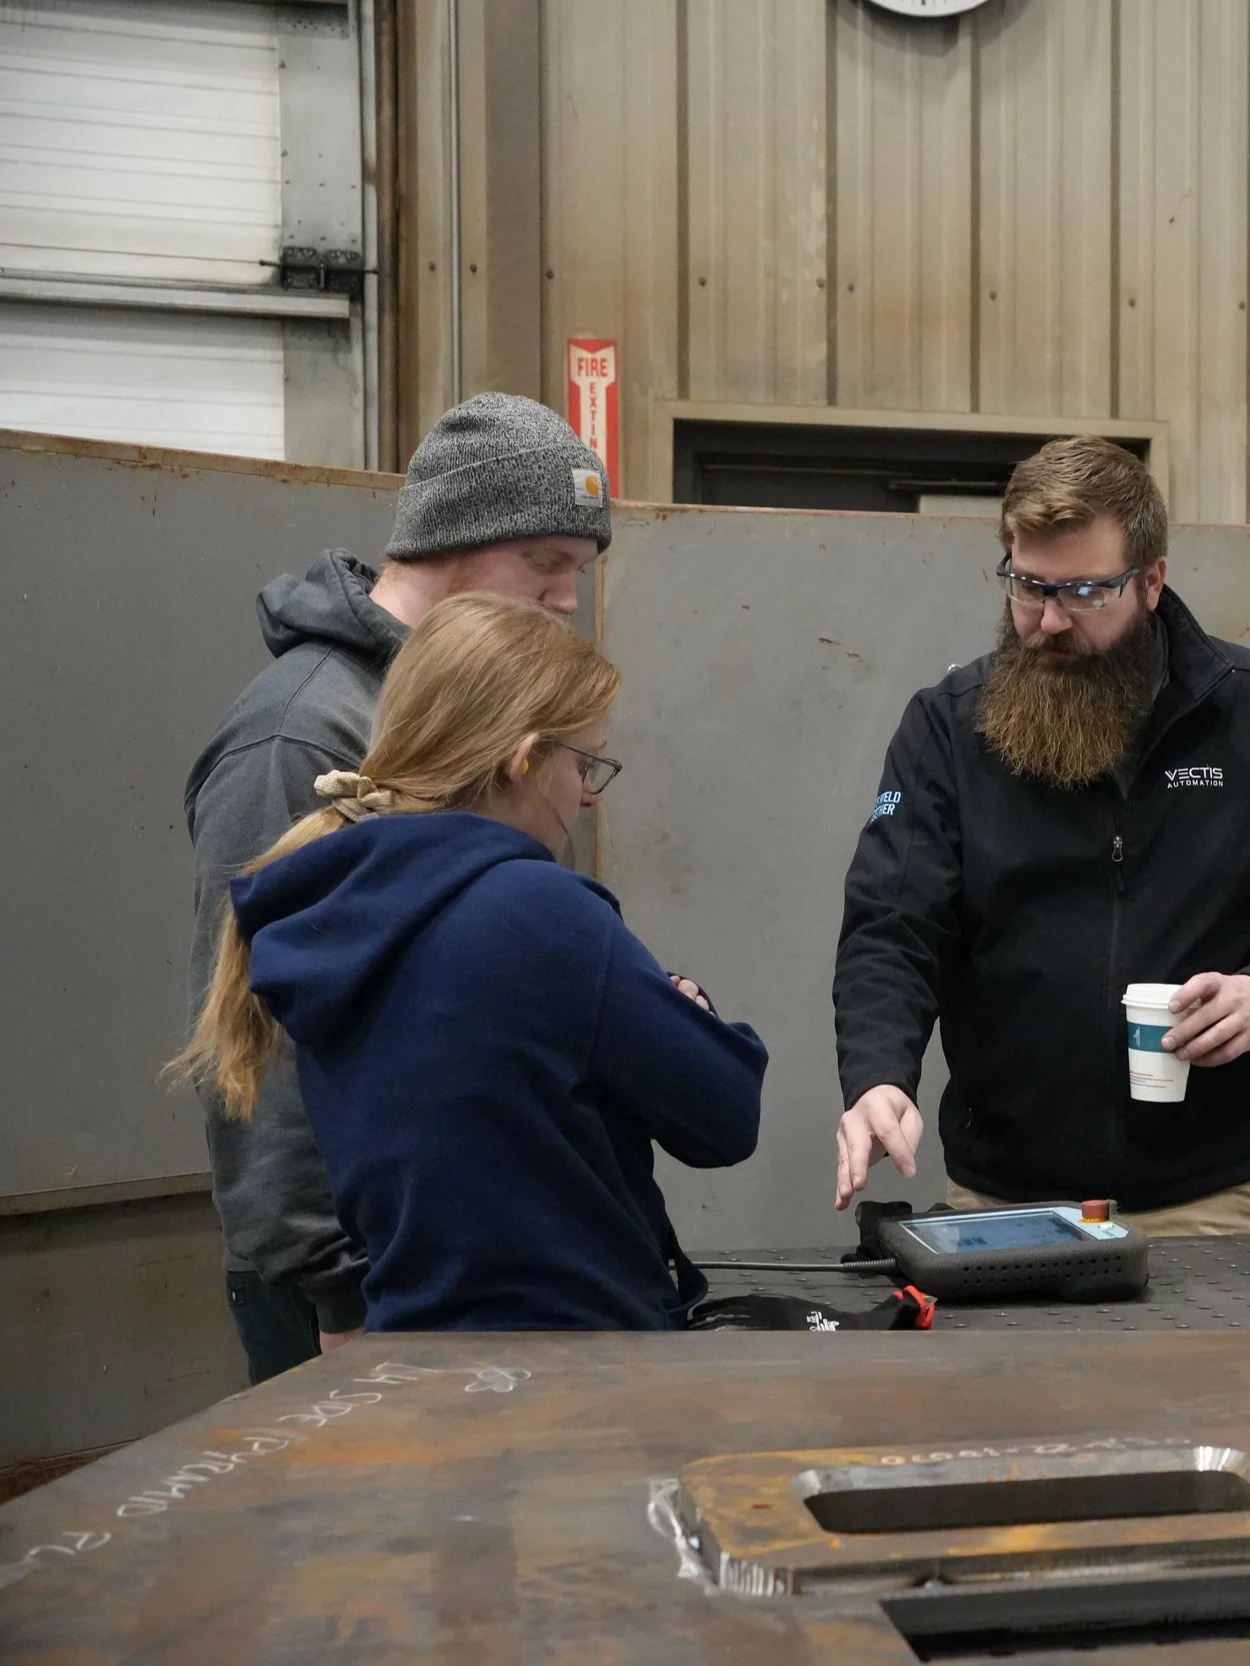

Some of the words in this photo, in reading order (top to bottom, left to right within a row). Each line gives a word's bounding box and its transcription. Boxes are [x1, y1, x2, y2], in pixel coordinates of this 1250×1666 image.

[577, 357, 608, 377] FIRE
[1164, 766, 1223, 781] VECTIS
[1167, 780, 1223, 789] AUTOMATION
[276, 1388, 384, 1428] SIDE
